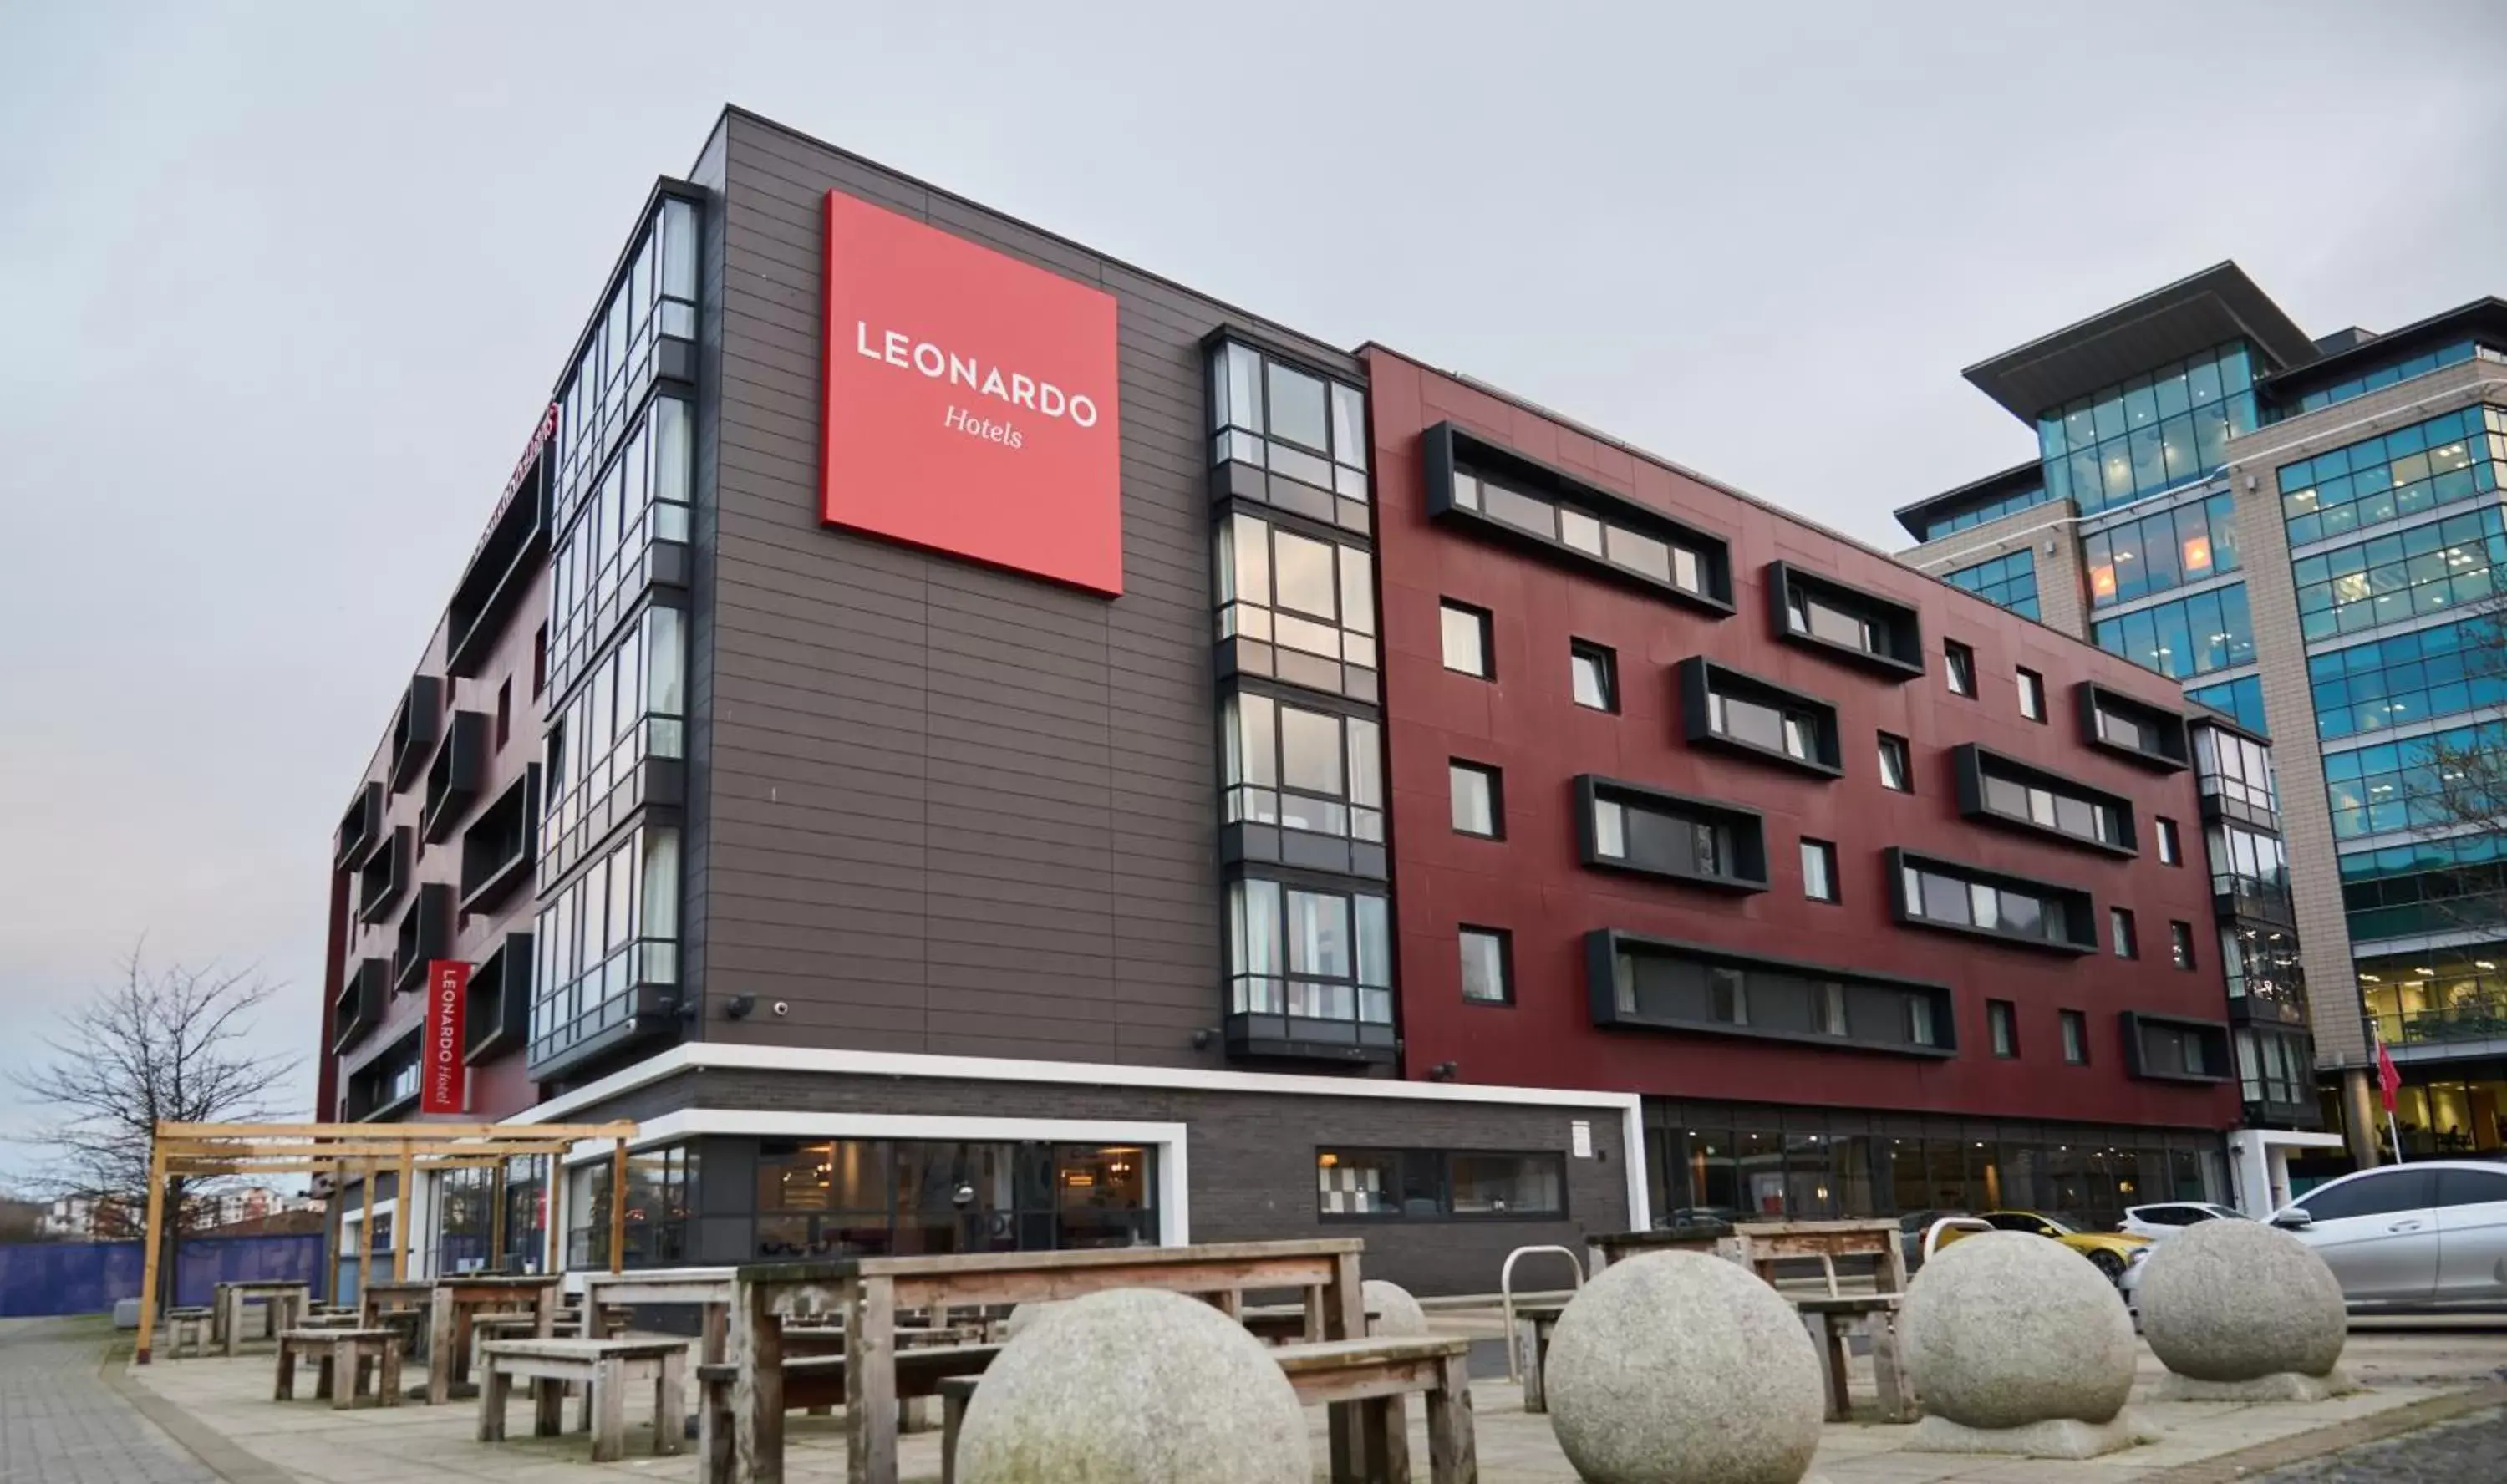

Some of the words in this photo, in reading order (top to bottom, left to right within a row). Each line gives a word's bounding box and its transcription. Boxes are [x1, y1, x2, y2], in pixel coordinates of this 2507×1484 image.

[857, 321, 1097, 428] LEONARDO
[943, 405, 1024, 450] Hotels
[439, 969, 457, 1063] LEONARDO
[435, 1065, 452, 1105] Hotel
